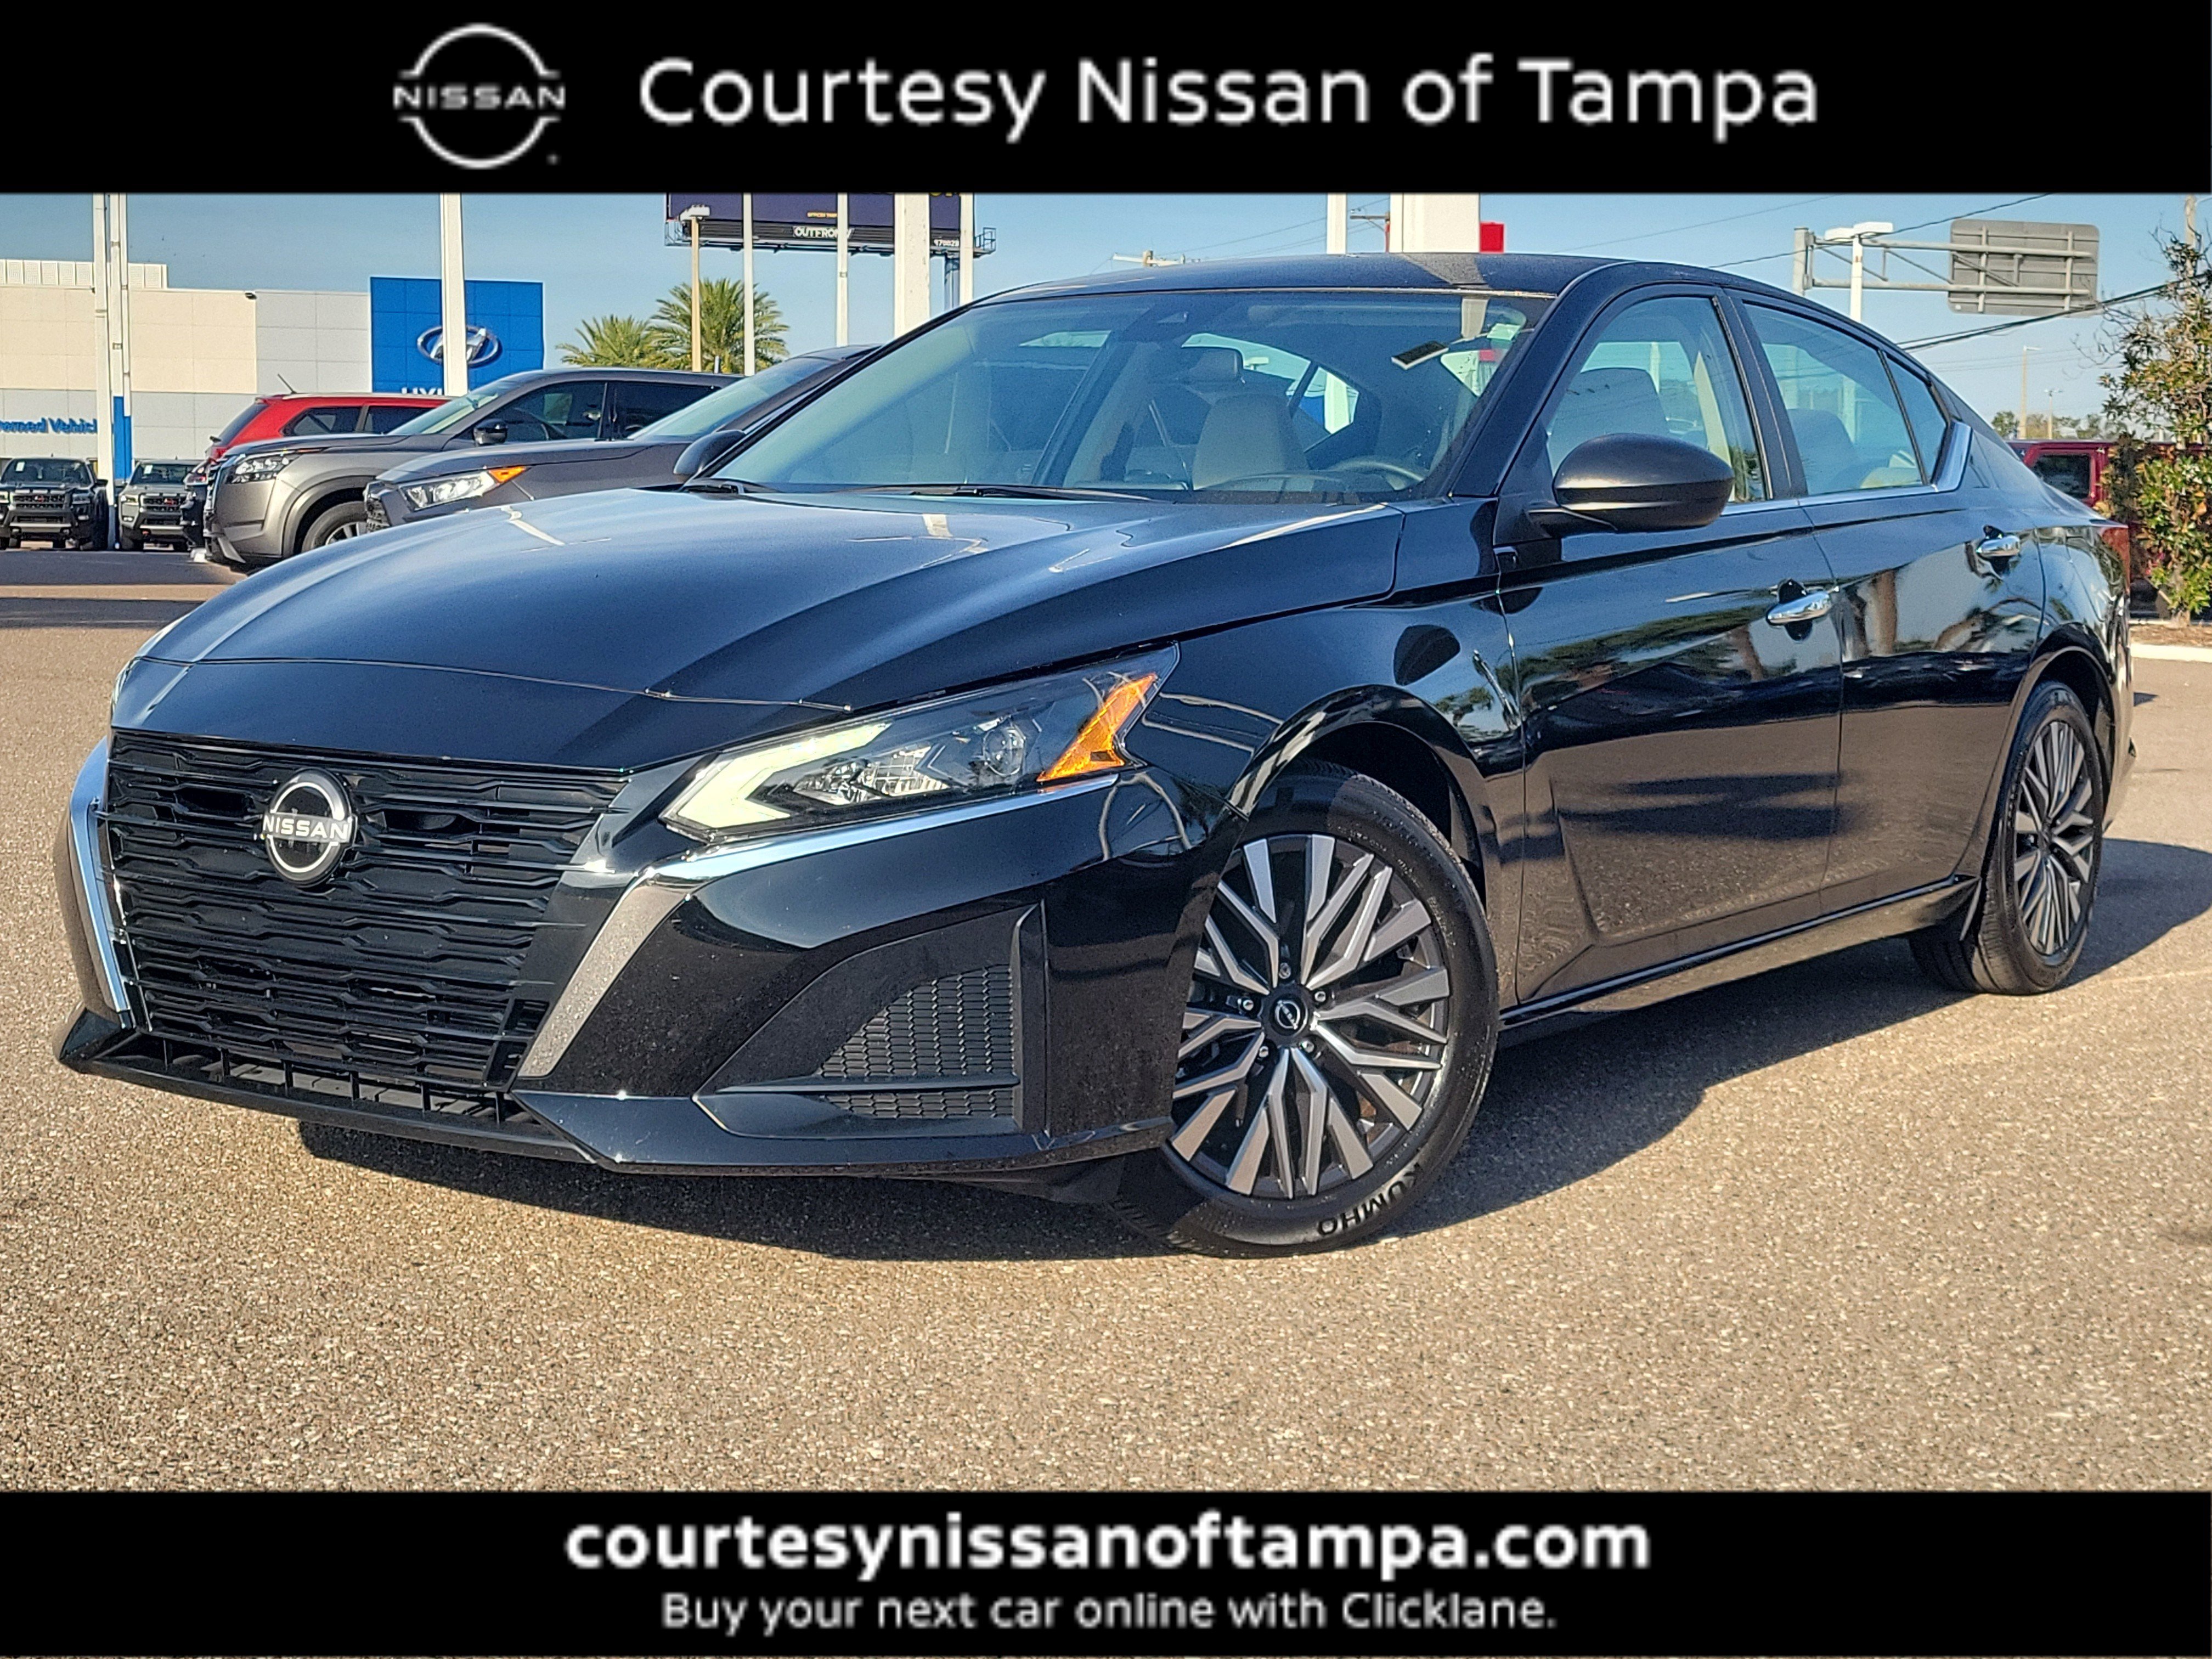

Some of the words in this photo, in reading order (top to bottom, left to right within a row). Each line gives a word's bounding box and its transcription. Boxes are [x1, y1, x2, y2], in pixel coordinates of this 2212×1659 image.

[48, 417, 98, 434] Vehicl
[263, 815, 348, 839] NISSAN
[1318, 1161, 1423, 1235] KUMHO
